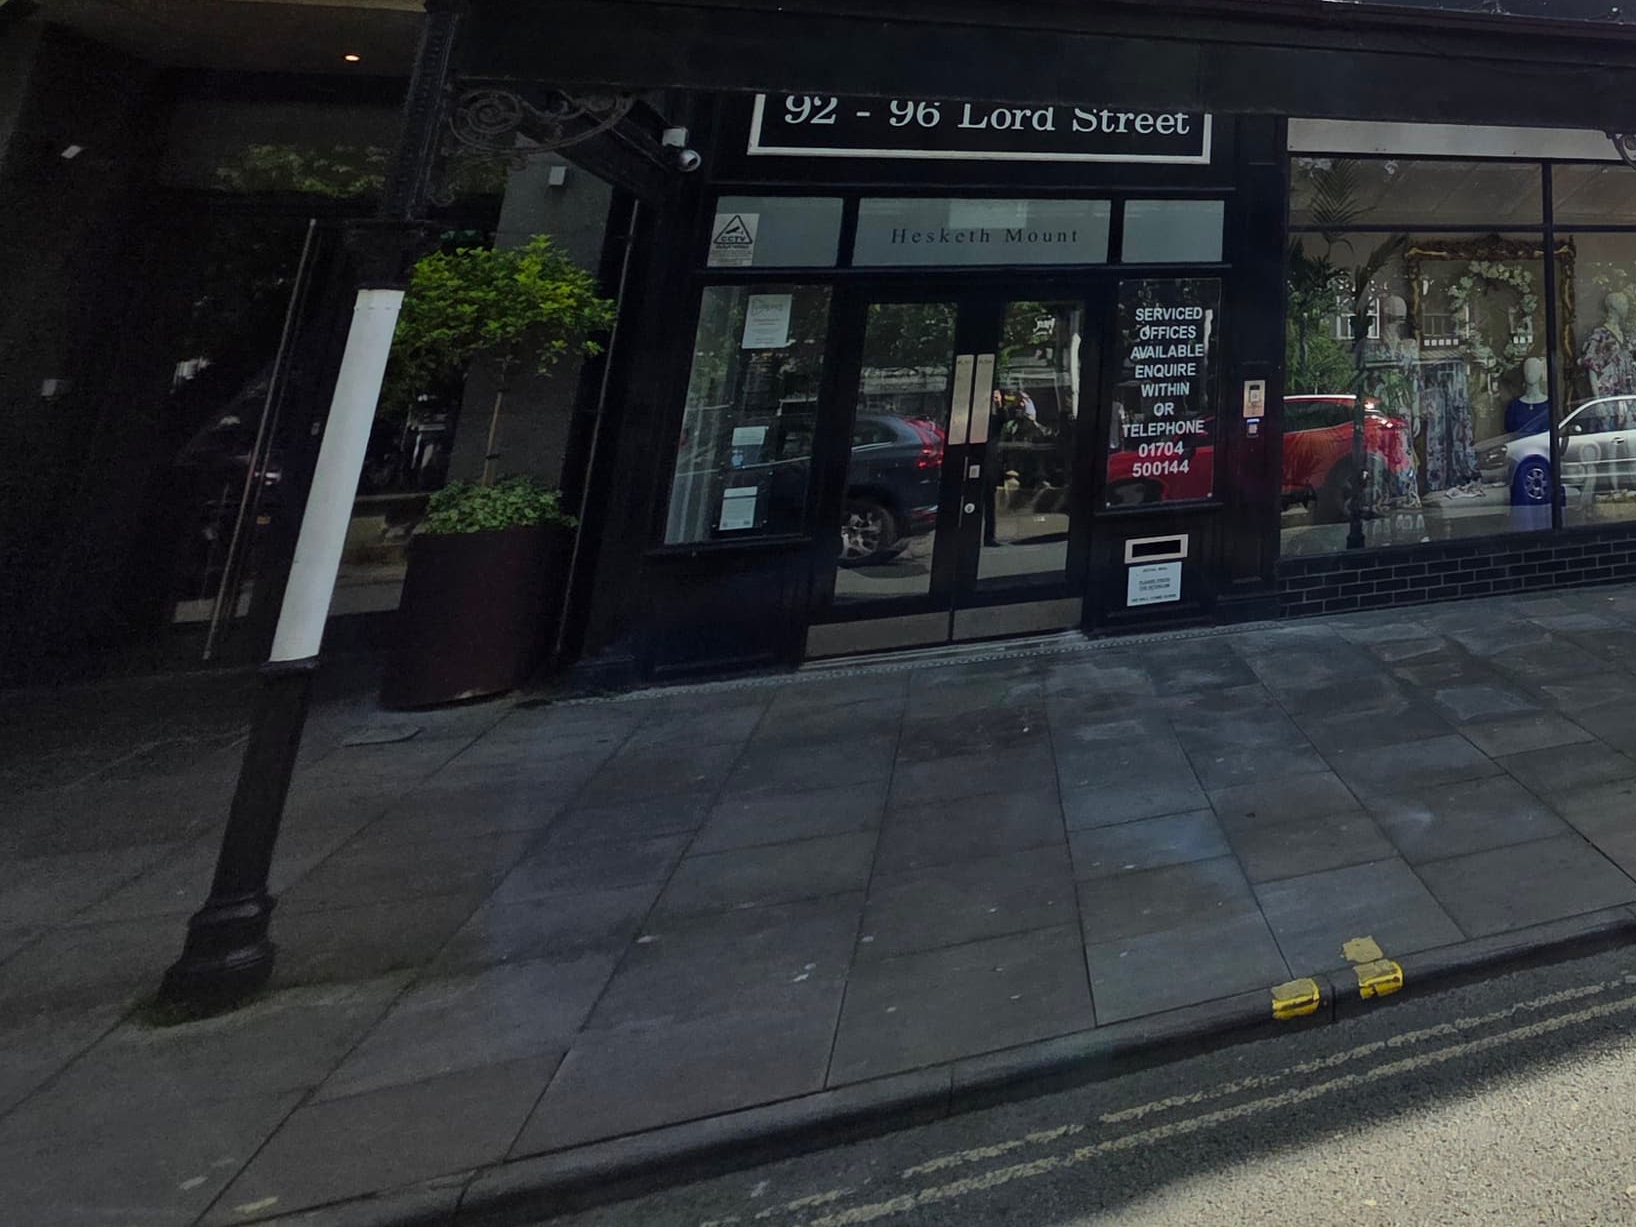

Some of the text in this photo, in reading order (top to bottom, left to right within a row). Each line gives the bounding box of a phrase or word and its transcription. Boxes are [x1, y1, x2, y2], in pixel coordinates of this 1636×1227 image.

[784, 96, 838, 124] 92
[889, 100, 941, 128] 96
[957, 103, 1056, 131] Lord
[1072, 108, 1191, 135] Street
[720, 235, 746, 243] CCTV
[891, 228, 1078, 244] Hesketh Mount
[1135, 307, 1203, 321] SERVICED
[1140, 325, 1197, 340] OFFICES
[1130, 344, 1205, 360] AVAILABLE
[1135, 363, 1197, 378] ENQUIRE
[1141, 382, 1190, 397] WITHIN
[1153, 402, 1175, 416] OR
[1122, 420, 1205, 438] TELEPHONE
[1138, 441, 1184, 458] 01704
[1132, 459, 1190, 478] 500144
